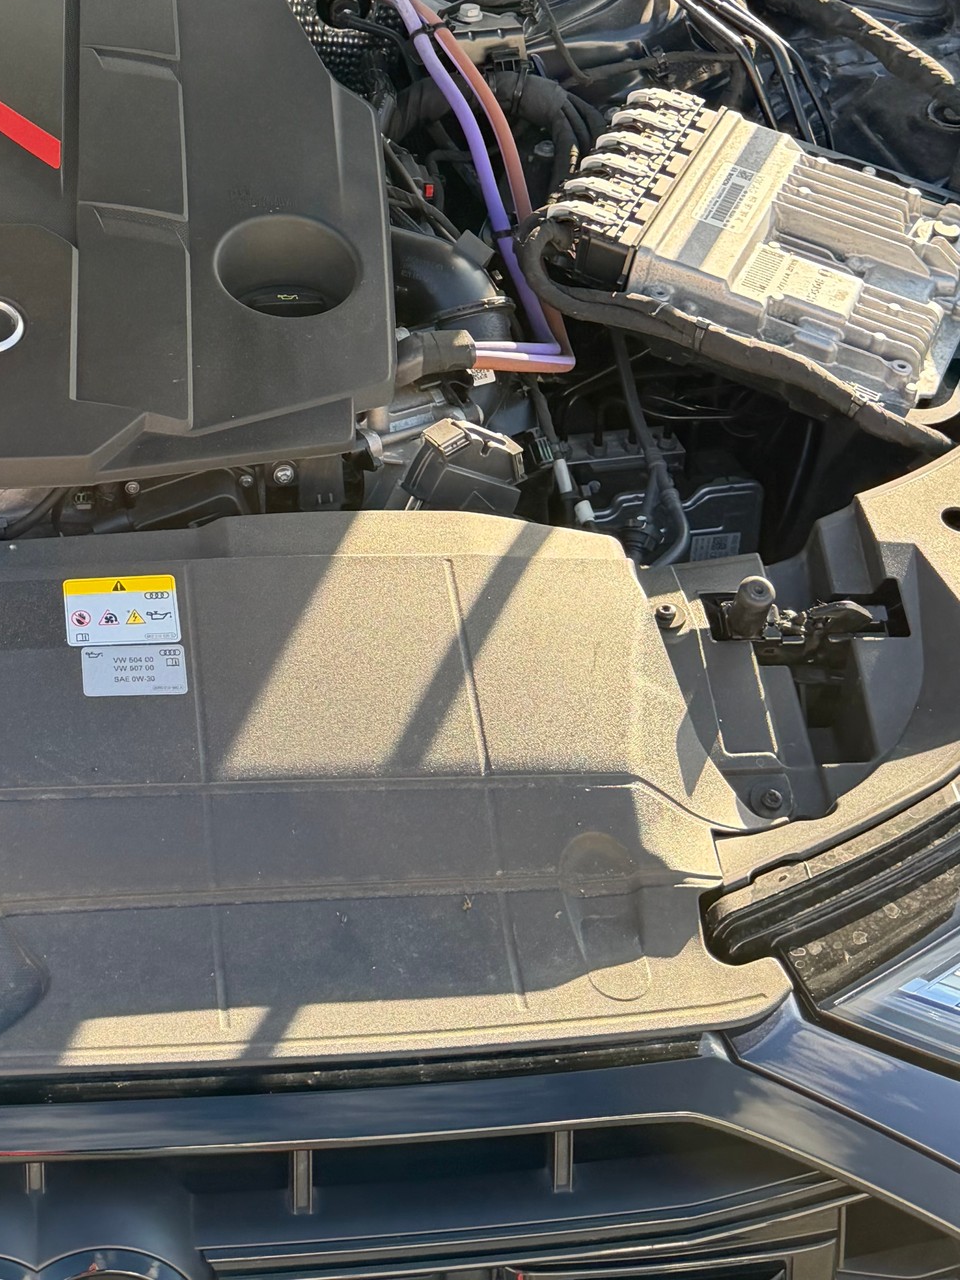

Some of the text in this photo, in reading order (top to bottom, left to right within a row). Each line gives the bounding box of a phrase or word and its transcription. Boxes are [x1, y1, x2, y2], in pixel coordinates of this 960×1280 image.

[112, 656, 127, 664] VW
[128, 656, 143, 664] 504
[114, 675, 131, 683] SAE
